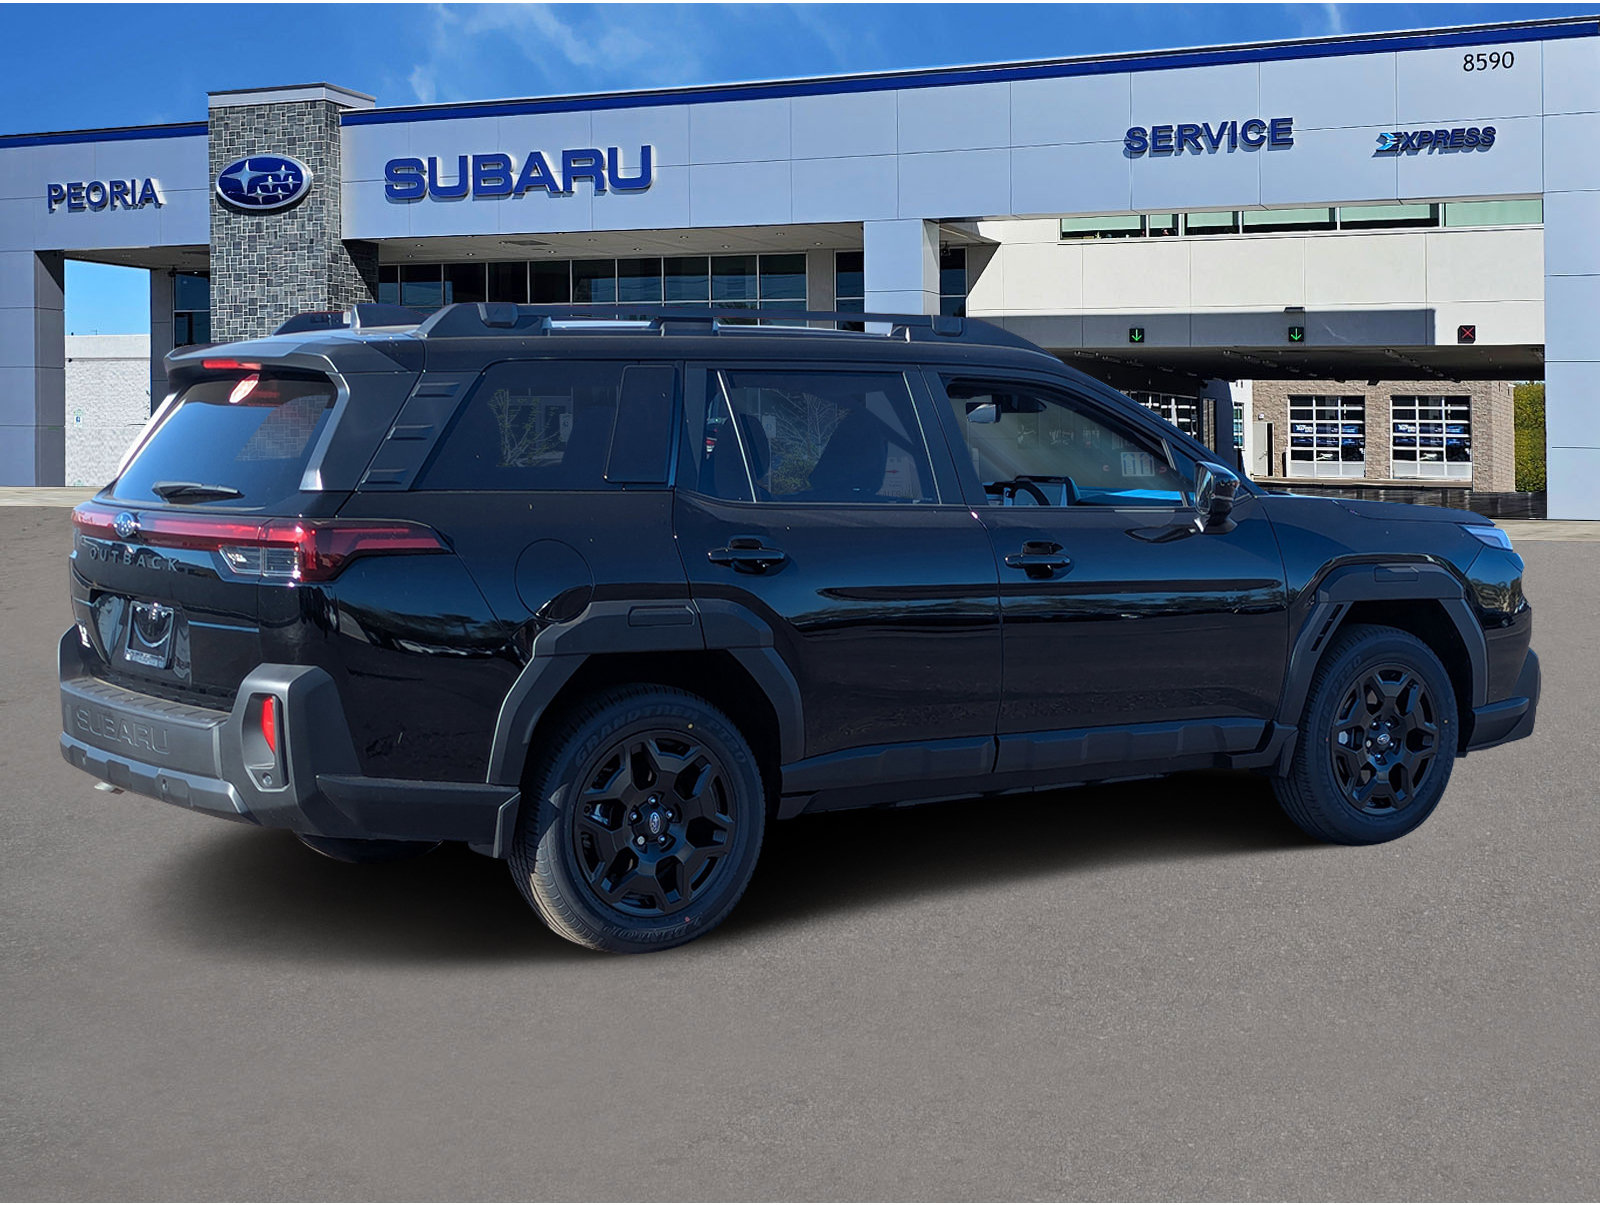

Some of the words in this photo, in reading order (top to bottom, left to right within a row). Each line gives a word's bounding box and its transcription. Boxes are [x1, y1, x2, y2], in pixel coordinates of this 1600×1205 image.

[1462, 51, 1515, 72] 8590
[1123, 117, 1295, 154] SERVICE
[1375, 126, 1497, 152] EXPRESS
[384, 144, 654, 203] SUBARU
[47, 178, 164, 212] PEORIA
[89, 547, 178, 572] OUTBACK
[76, 709, 170, 755] SUBARU
